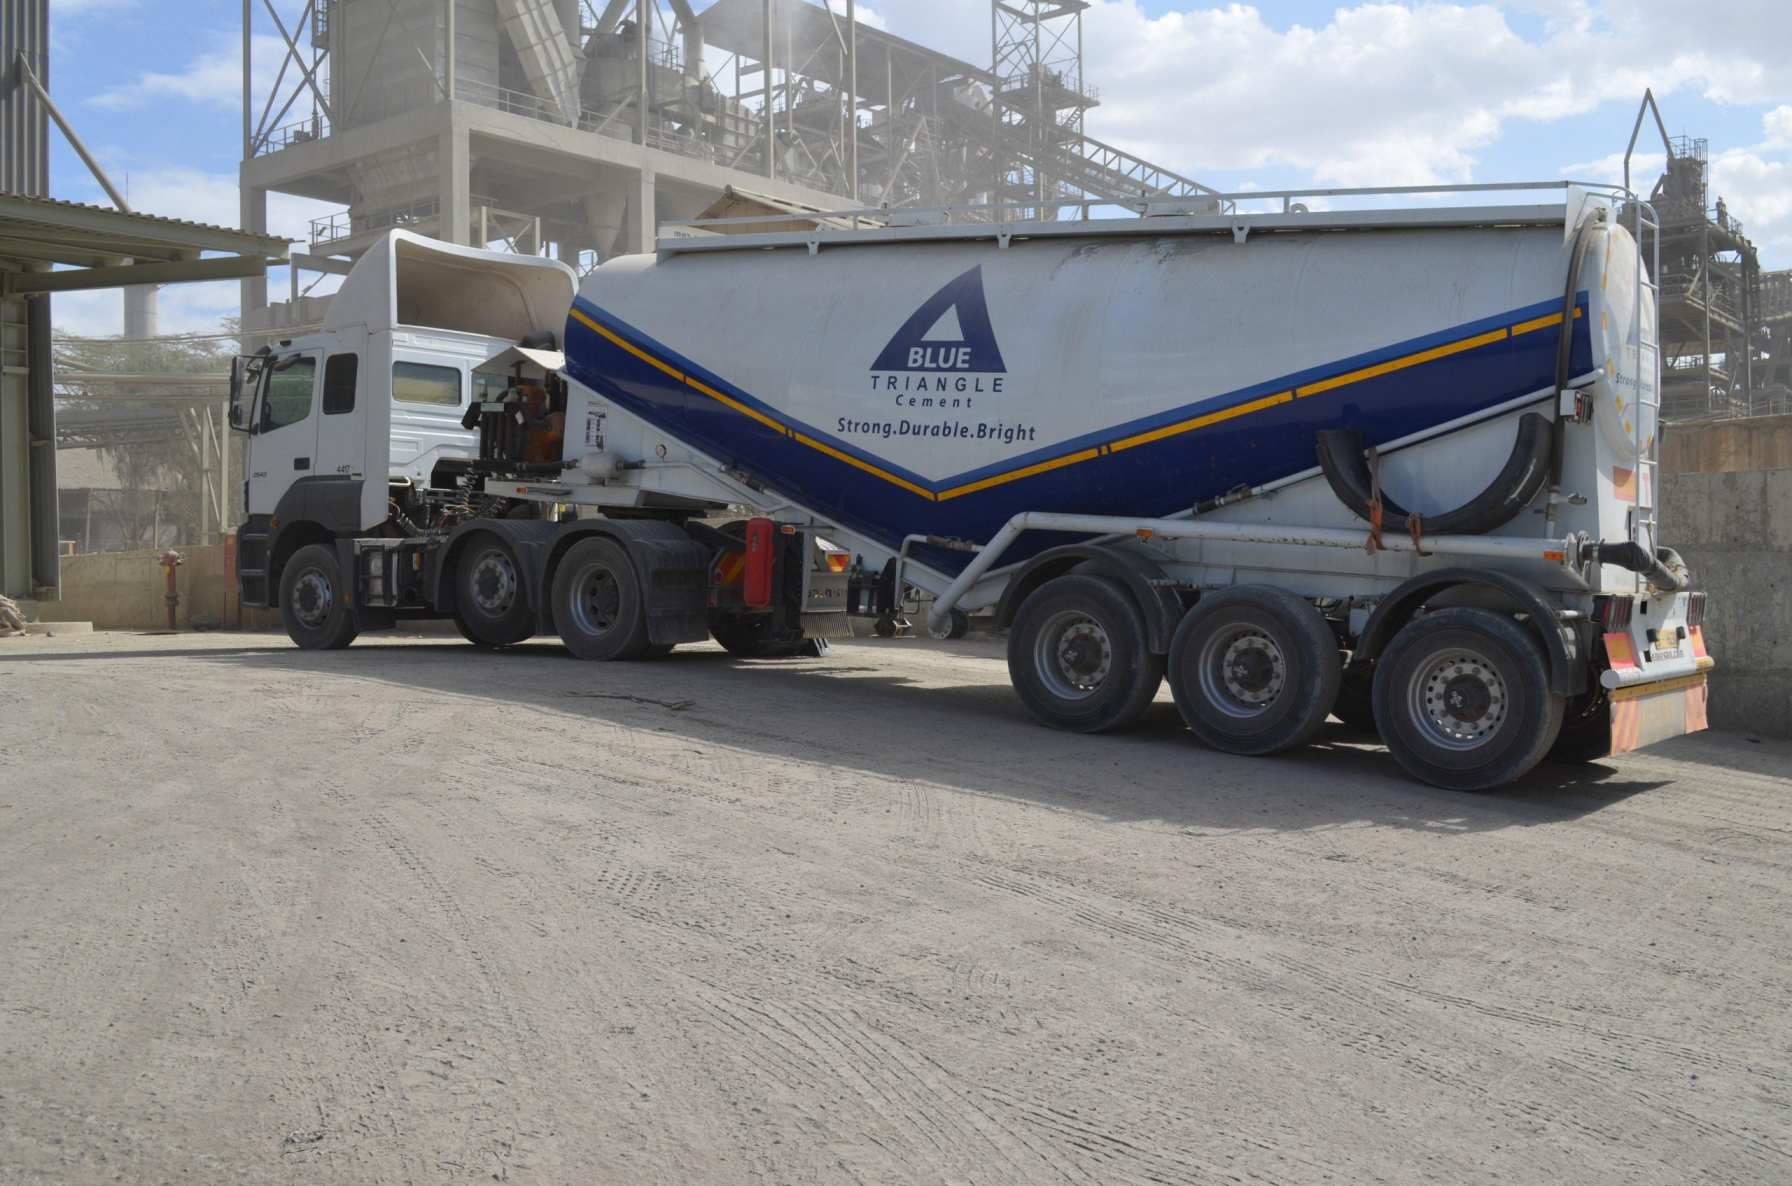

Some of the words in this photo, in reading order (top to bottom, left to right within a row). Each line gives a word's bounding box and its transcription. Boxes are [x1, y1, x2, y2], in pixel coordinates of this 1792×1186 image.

[907, 347, 972, 368] BLUE
[871, 375, 1004, 393] TRIANGLE
[895, 394, 972, 408] Cement
